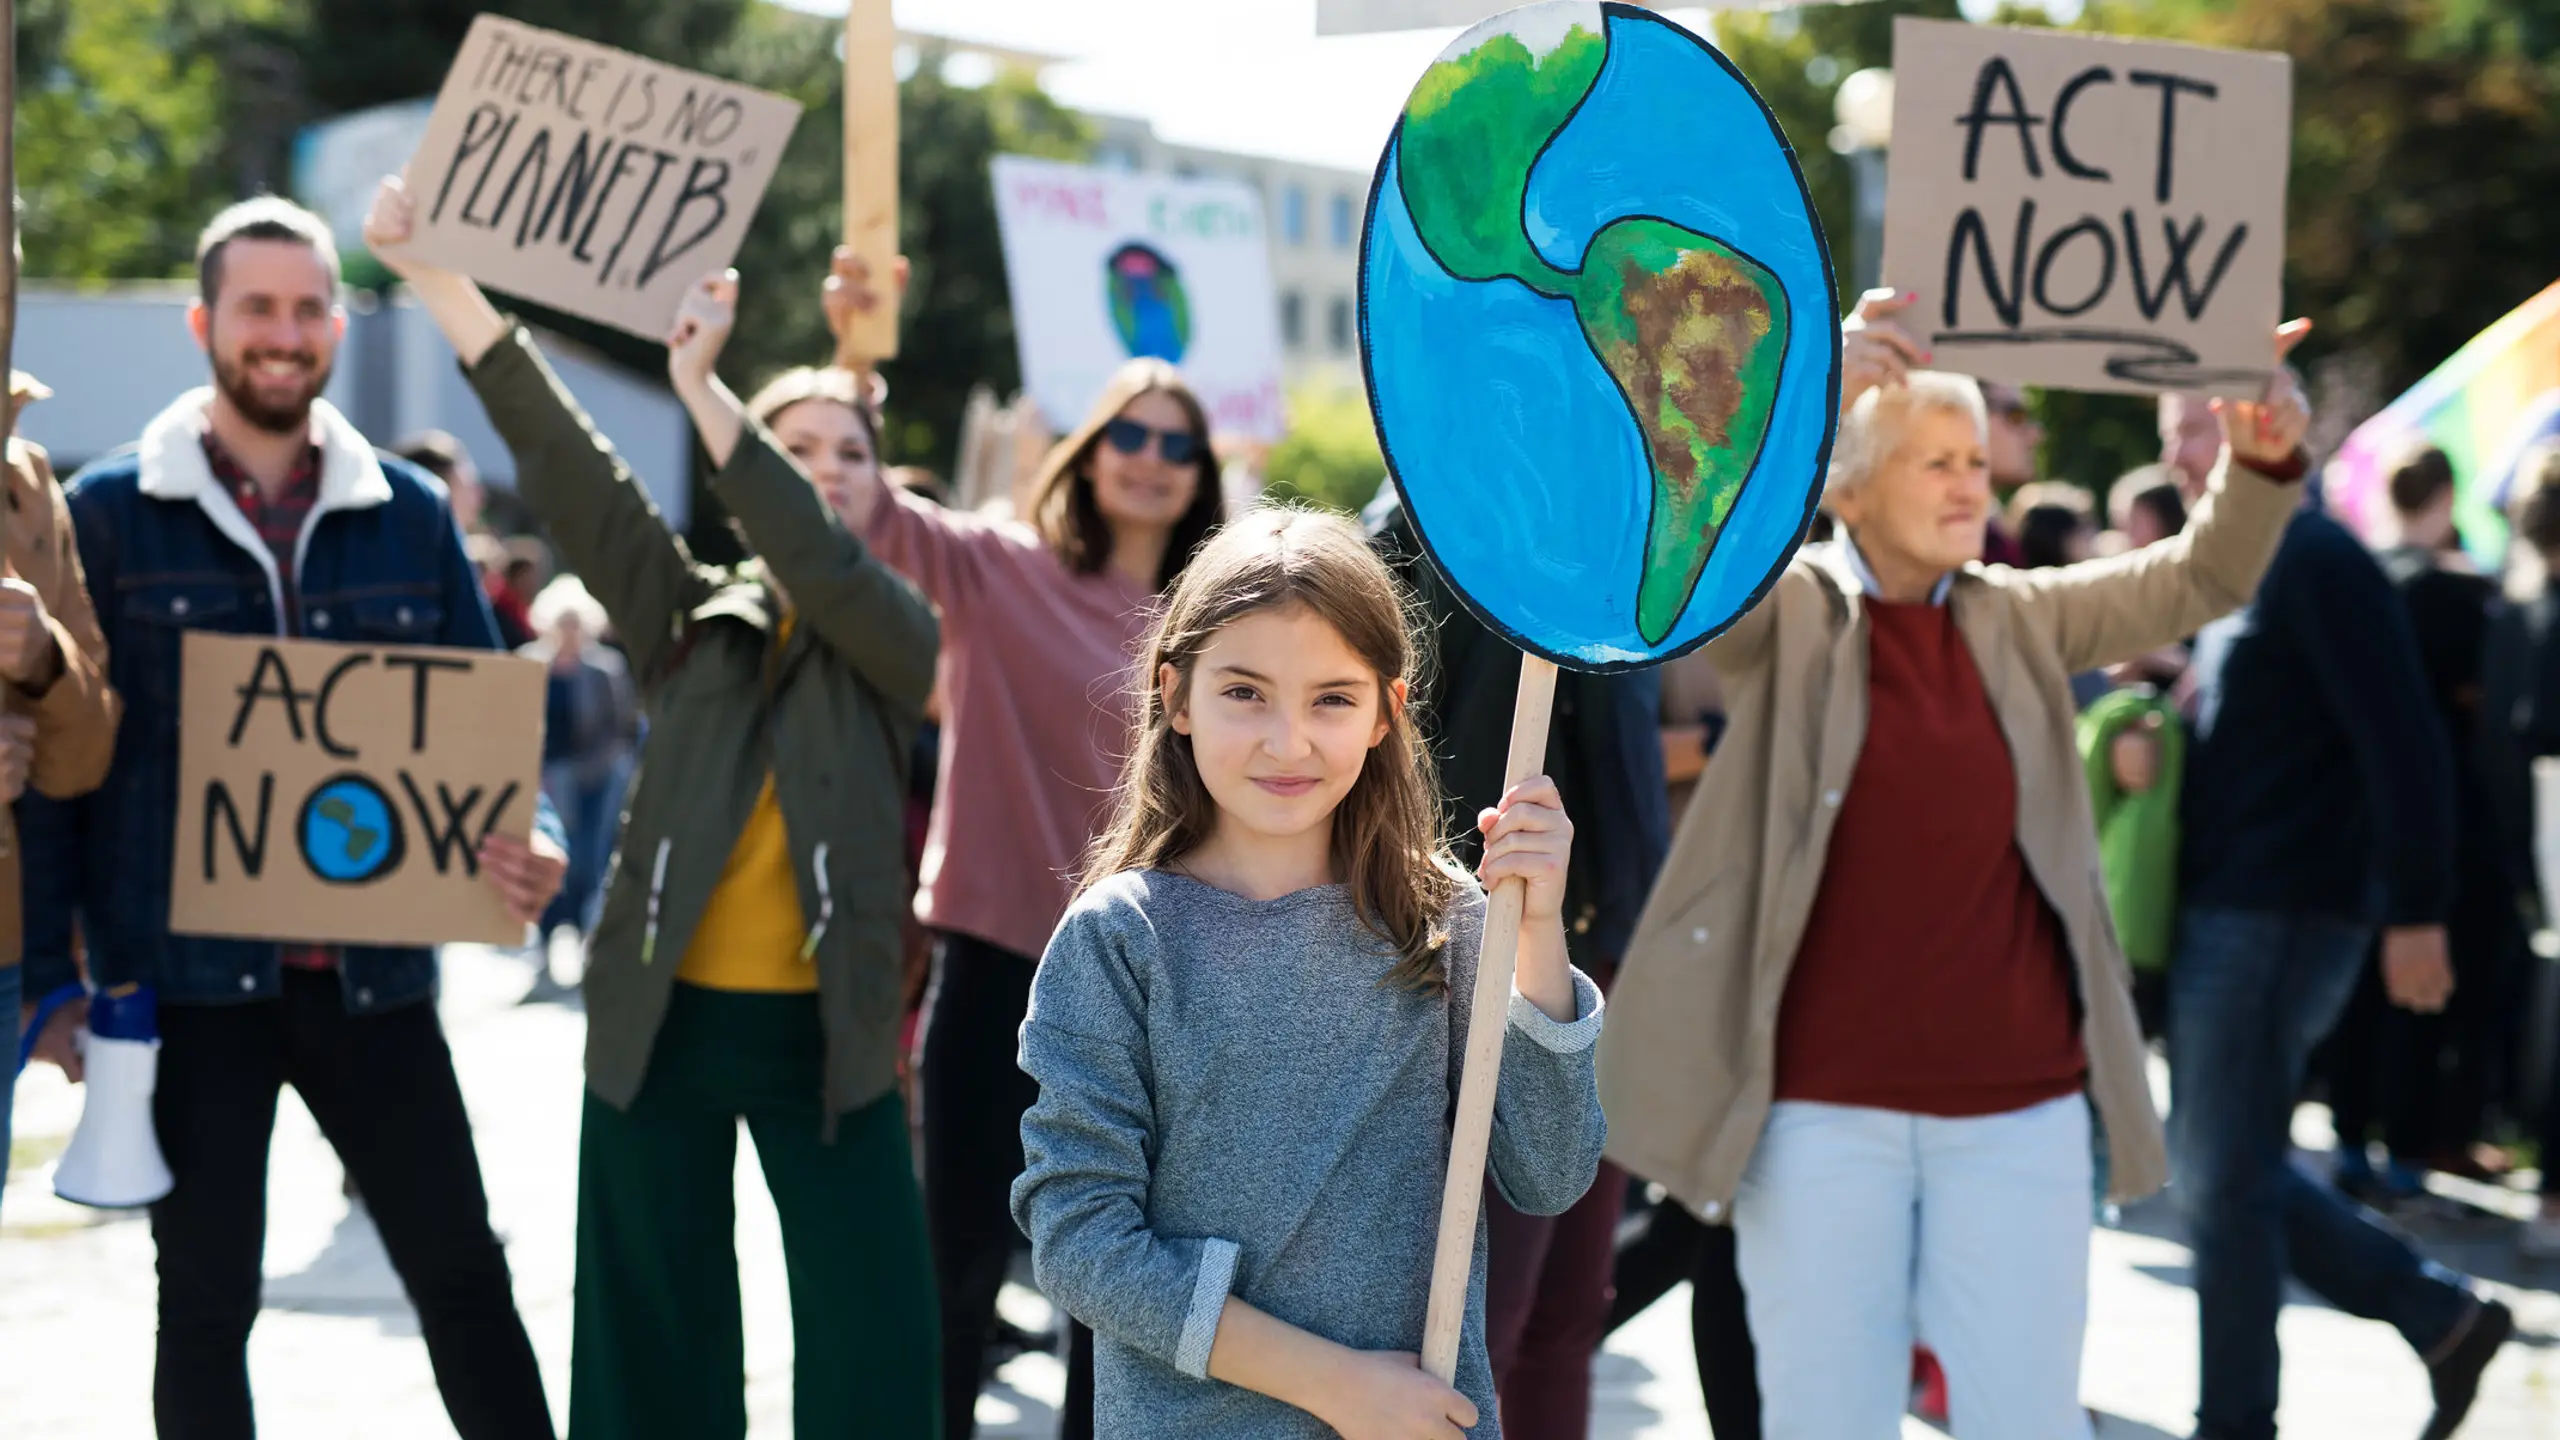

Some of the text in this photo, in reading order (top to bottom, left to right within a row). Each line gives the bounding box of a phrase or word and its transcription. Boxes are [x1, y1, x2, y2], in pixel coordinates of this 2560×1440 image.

[472, 30, 744, 148] THERE IS NO
[1954, 55, 2219, 204] ACT
[430, 101, 679, 287] PLANET
[1943, 198, 2249, 329] NOW
[227, 646, 473, 759] ACT
[203, 769, 520, 887] NOW
